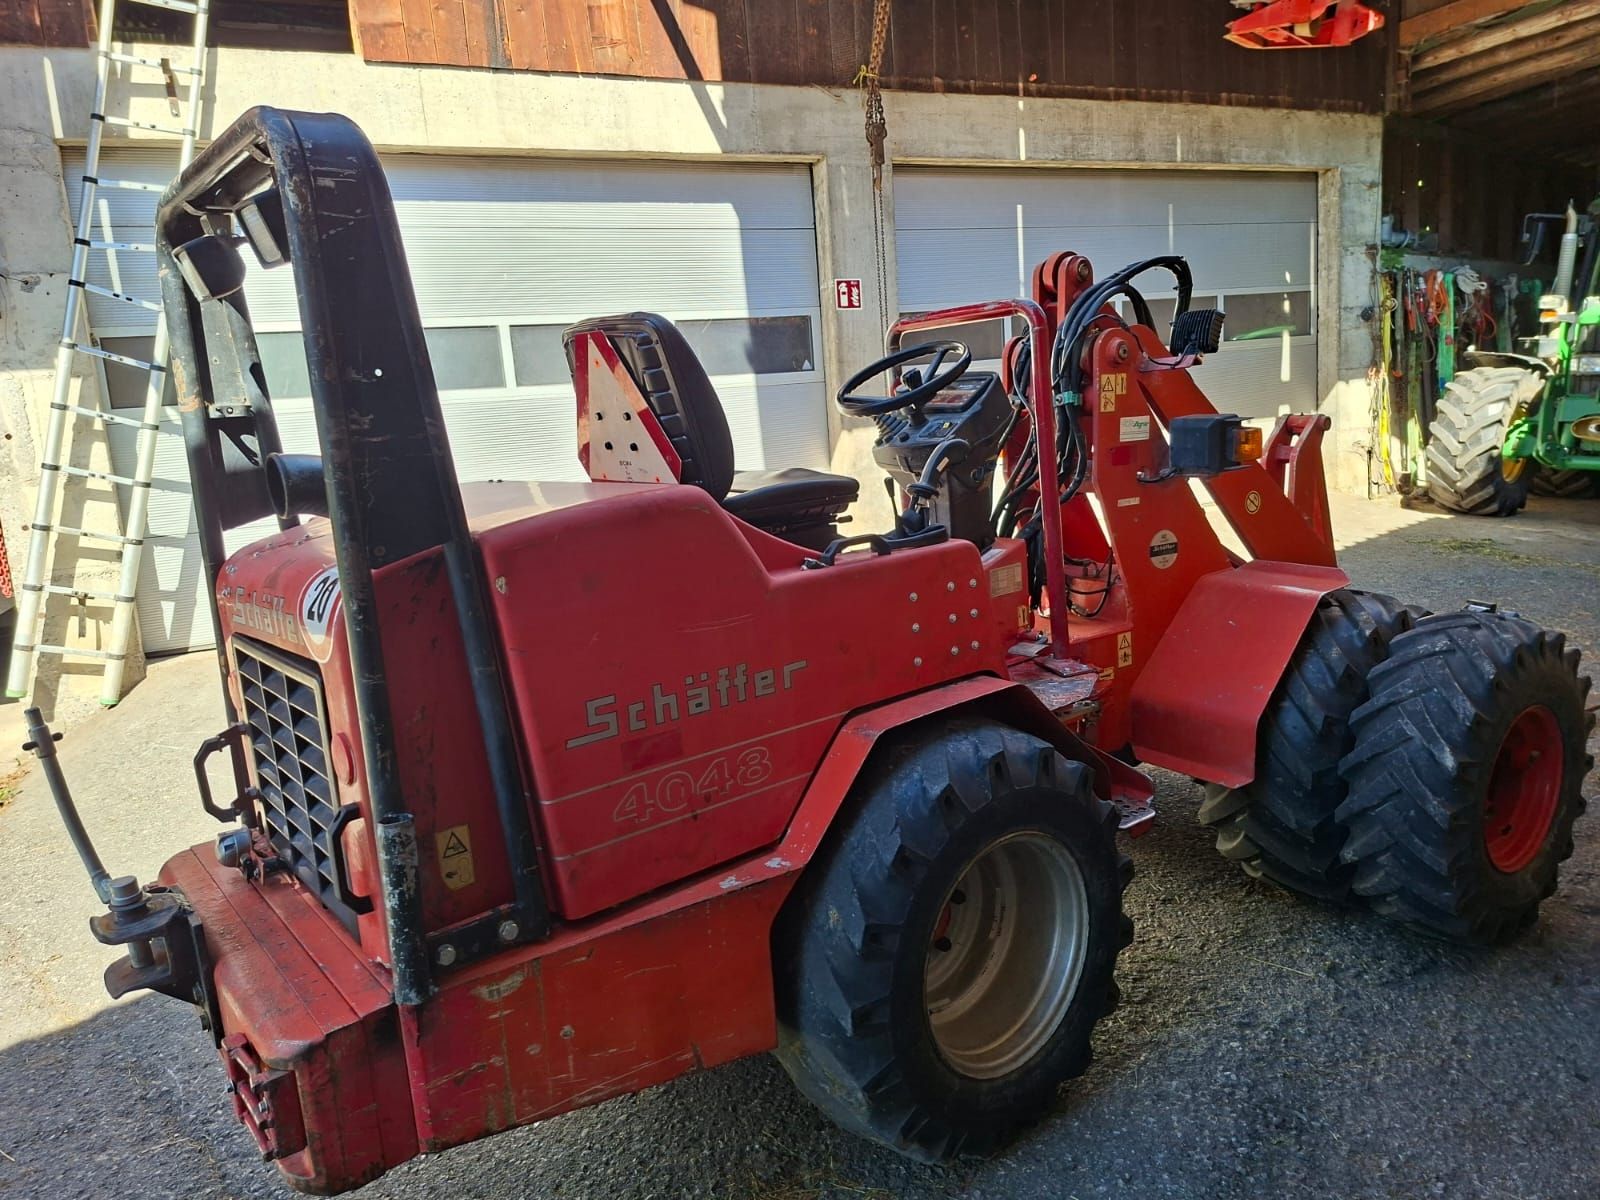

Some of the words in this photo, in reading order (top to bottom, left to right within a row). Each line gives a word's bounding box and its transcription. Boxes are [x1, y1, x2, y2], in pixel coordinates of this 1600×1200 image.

[307, 575, 339, 624] 20
[565, 660, 808, 750] Schäffer
[613, 746, 773, 824] 4048
